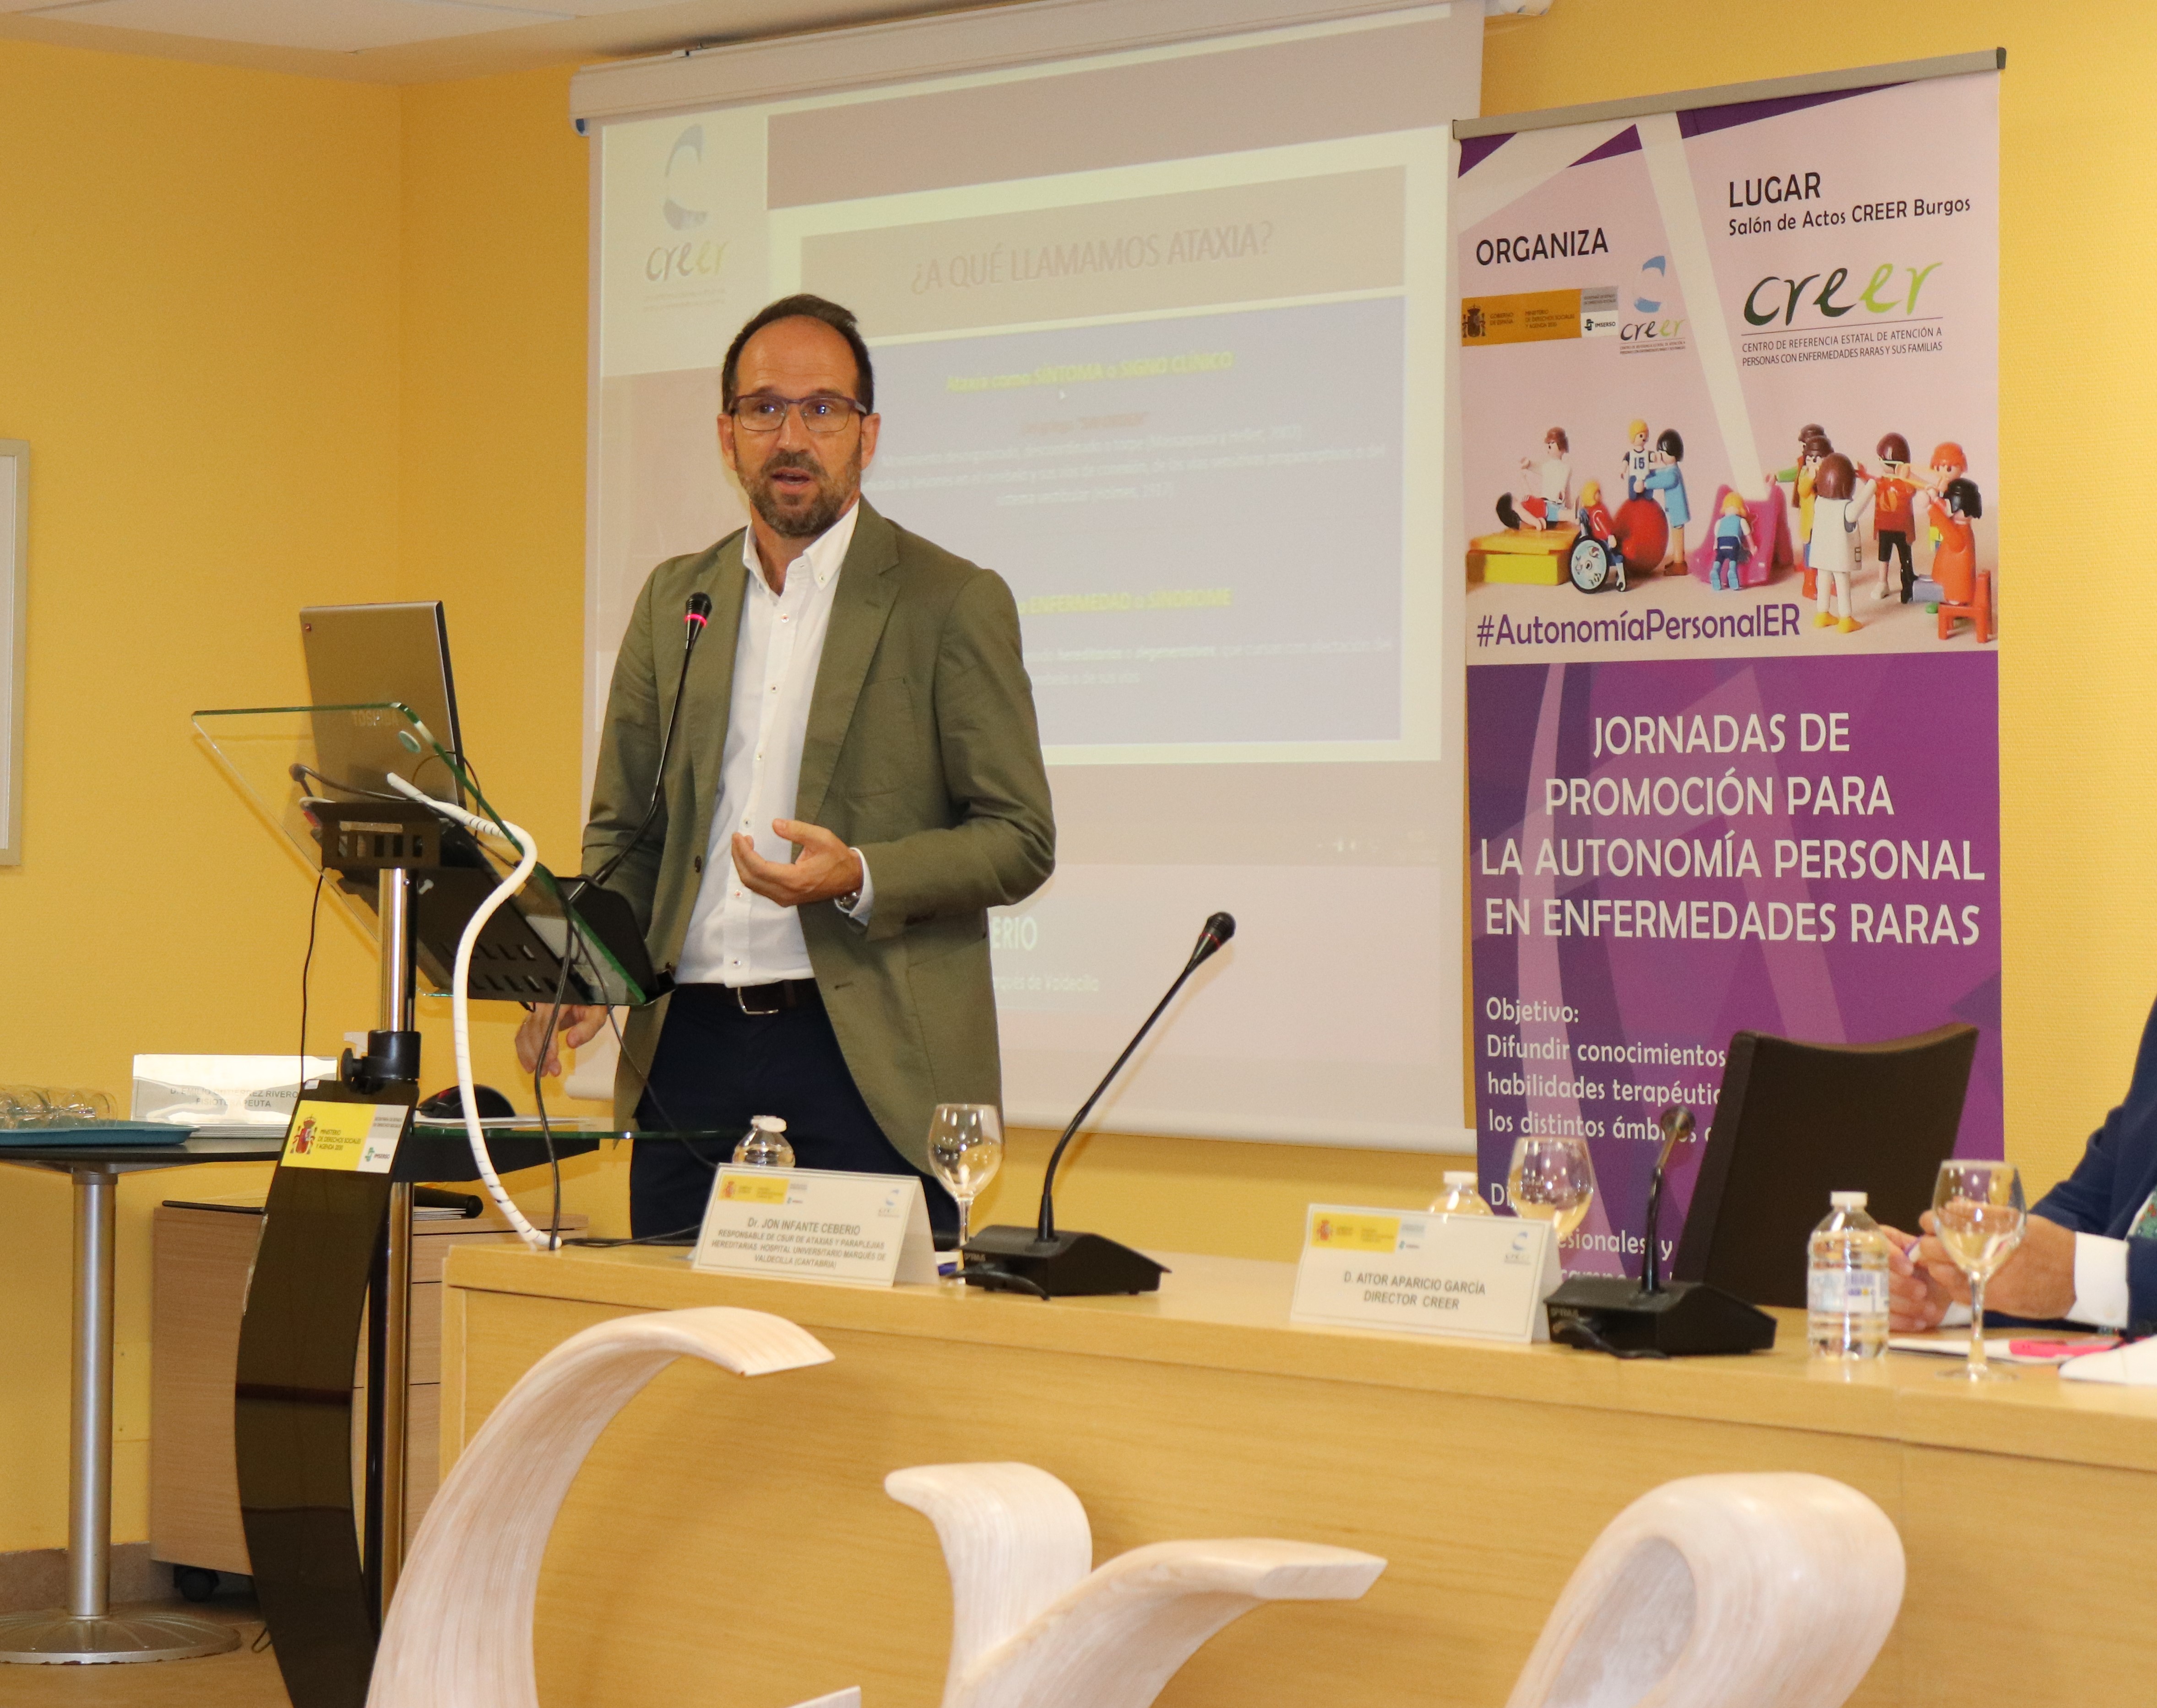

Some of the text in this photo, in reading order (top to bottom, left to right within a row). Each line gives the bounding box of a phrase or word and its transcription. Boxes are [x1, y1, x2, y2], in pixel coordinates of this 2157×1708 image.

[1729, 172, 1821, 207] LUGAR
[1728, 197, 1971, 236] Salón de Actos CREER Burgos
[646, 240, 730, 281] creer
[949, 243, 1004, 288] QUÉ
[1011, 234, 1160, 282] LLAMAMOS
[1168, 220, 1274, 266] ATAXIA?
[1476, 228, 1608, 266] ORGANIZA
[1744, 262, 1942, 326] creer
[1620, 320, 1685, 341] creer
[1742, 327, 1942, 353] CENTRO DE REFERENCIA ESTATAL DE ATENCIÓN A
[1742, 342, 1942, 367] PERSONAS CON ENFERMEDADES RARAS Y SUS FAMILIAS
[1477, 604, 1800, 648] #AutonomíaPersonalER
[1593, 713, 1850, 758] JORNADAS DE
[1545, 767, 1894, 816] PROMOCIÓN PARA
[1481, 830, 1985, 880] LA AUTONOMÍA PERSONAL
[1485, 898, 1980, 946] EN ENFERMEDADES RARAS
[1486, 996, 1580, 1025] Objetivo:
[1487, 1034, 1726, 1067] Difundir conocimientos
[1488, 1071, 1605, 1100] habilidades
[196, 1098, 272, 1107] FISIOTERAPEUTA
[1489, 1108, 1513, 1132] los
[1520, 1110, 1605, 1138] distintos
[718, 1229, 764, 1240] RESPONSABLE
[806, 1237, 833, 1246] ATAXIAS
[748, 1217, 861, 1236] Dr. JON INFANTE CEBERIO
[712, 1240, 757, 1250] HEREDITARIAS
[761, 1244, 791, 1253] HOSPITAL
[793, 1246, 842, 1258] UNIVERSITARIO
[877, 1253, 886, 1261] DE
[755, 1254, 837, 1270] VALDECILLA (CANTABRIA)
[1661, 1240, 1673, 1261] y
[1344, 1271, 1486, 1295] D. AITOR APARICIO GARCÍA
[1364, 1290, 1460, 1310] DIRECTOR CREER
